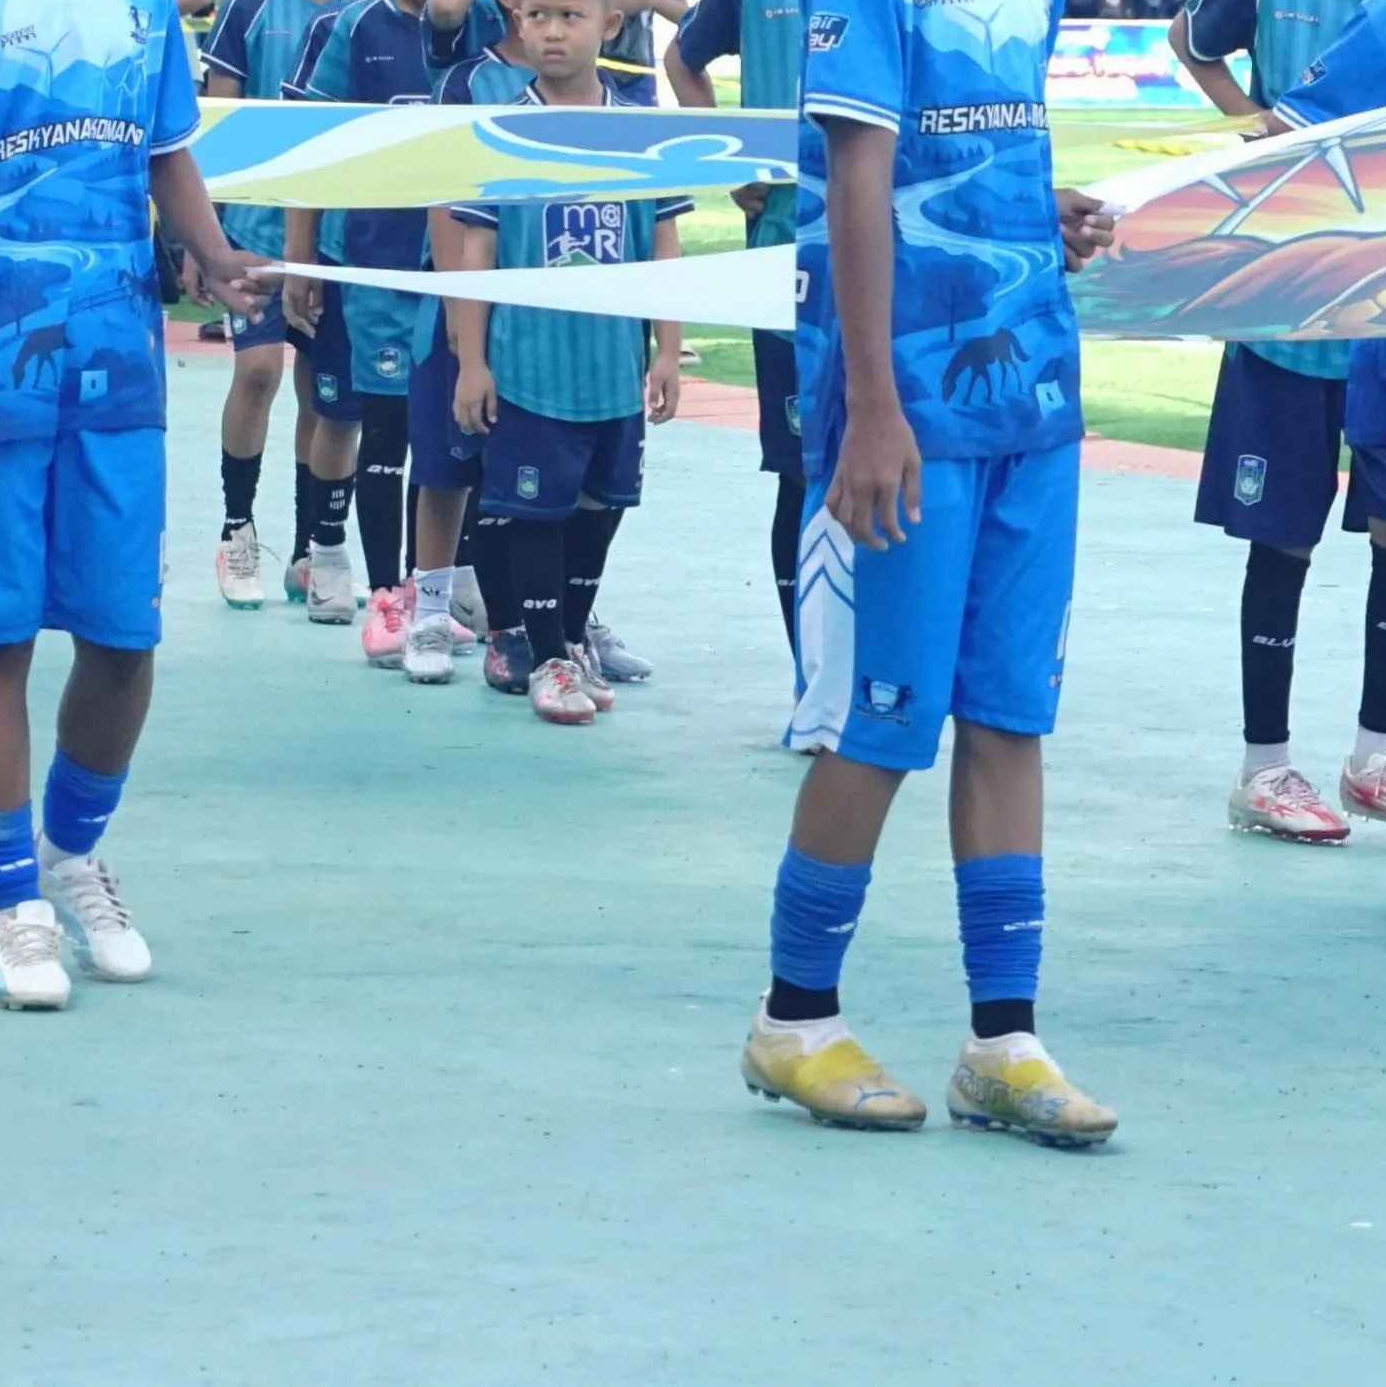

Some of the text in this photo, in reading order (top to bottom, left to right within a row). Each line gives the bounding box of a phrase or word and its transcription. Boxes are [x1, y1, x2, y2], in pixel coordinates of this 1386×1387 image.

[808, 15, 842, 30] air
[808, 33, 837, 52] ay
[918, 103, 1028, 134] RESKYANA
[523, 598, 559, 610] evo
